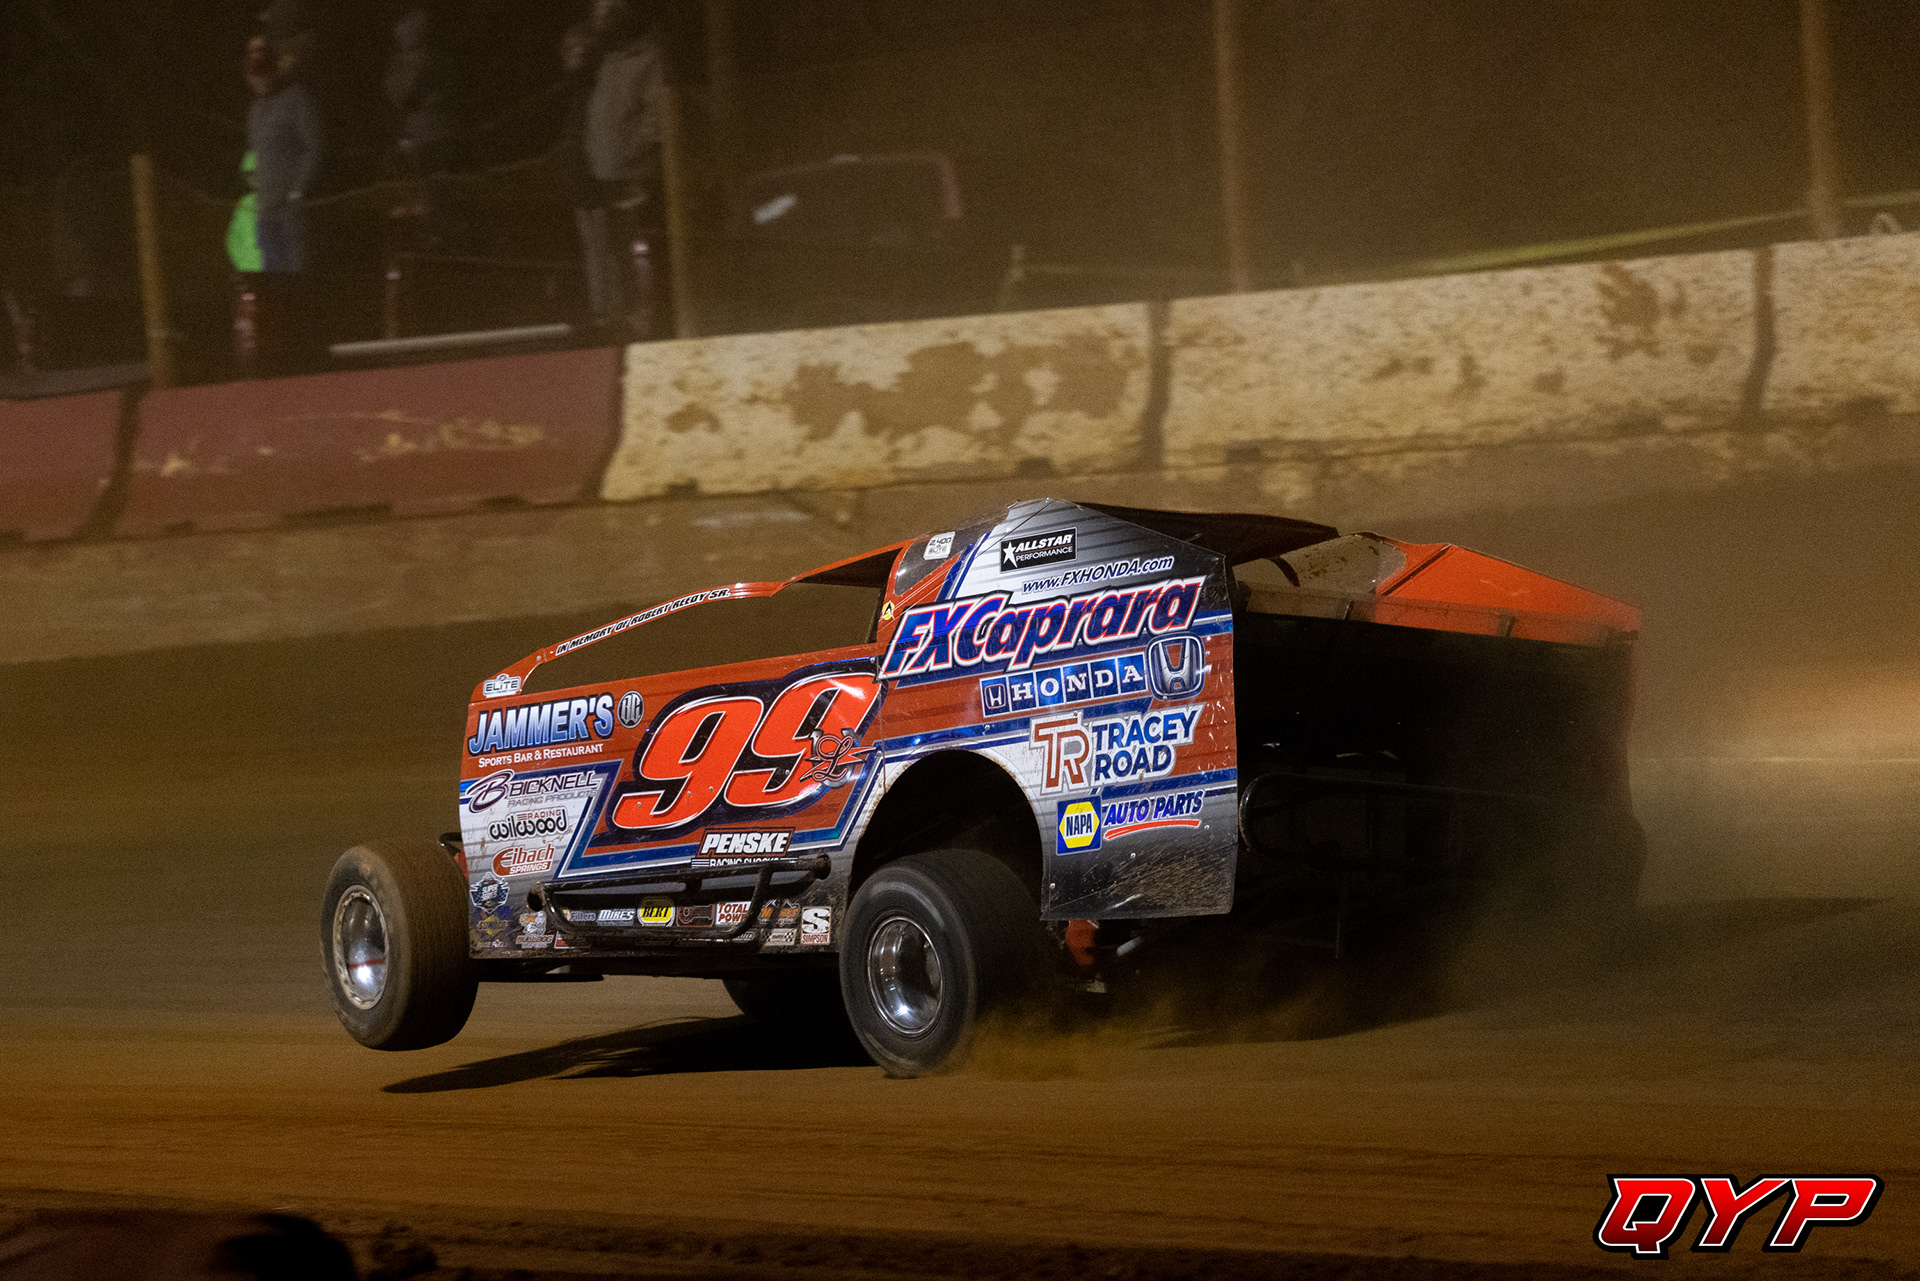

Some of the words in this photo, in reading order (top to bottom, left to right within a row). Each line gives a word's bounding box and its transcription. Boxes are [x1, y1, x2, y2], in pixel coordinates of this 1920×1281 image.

[1015, 534, 1073, 552] ALLSTAR
[1015, 546, 1073, 562] PERFORMANCE
[1023, 557, 1173, 593] www.FXHONDA.com
[556, 643, 569, 655] IN
[569, 626, 614, 649] MEMORY
[615, 619, 629, 632] OF
[630, 603, 671, 625] ROBERT
[709, 588, 730, 600] SR.
[1012, 664, 1144, 702] HONDA
[468, 694, 614, 754] JAMMER'S
[1091, 710, 1197, 751] TRACEY
[478, 755, 513, 768] SPORTS
[513, 752, 534, 764] BAR
[534, 750, 542, 760] &
[543, 743, 604, 759] RESTAURANT
[612, 673, 882, 829] 99
[1034, 717, 1090, 789] TR
[1094, 745, 1172, 781] ROAD
[509, 771, 598, 797] BICKNELL
[508, 796, 544, 808] RACING
[544, 790, 597, 803] PRODUCTS
[1103, 800, 1150, 827] AUTO
[1153, 791, 1204, 819] PARTS
[489, 808, 568, 839] wilwood
[527, 809, 562, 820] RACING
[1065, 813, 1093, 837] NAPA
[700, 832, 790, 854] PENSKE
[493, 844, 554, 873] Eibach
[509, 862, 549, 875] SPRINGS
[718, 903, 749, 914] TOTAL
[802, 934, 829, 945] SIMPSON
